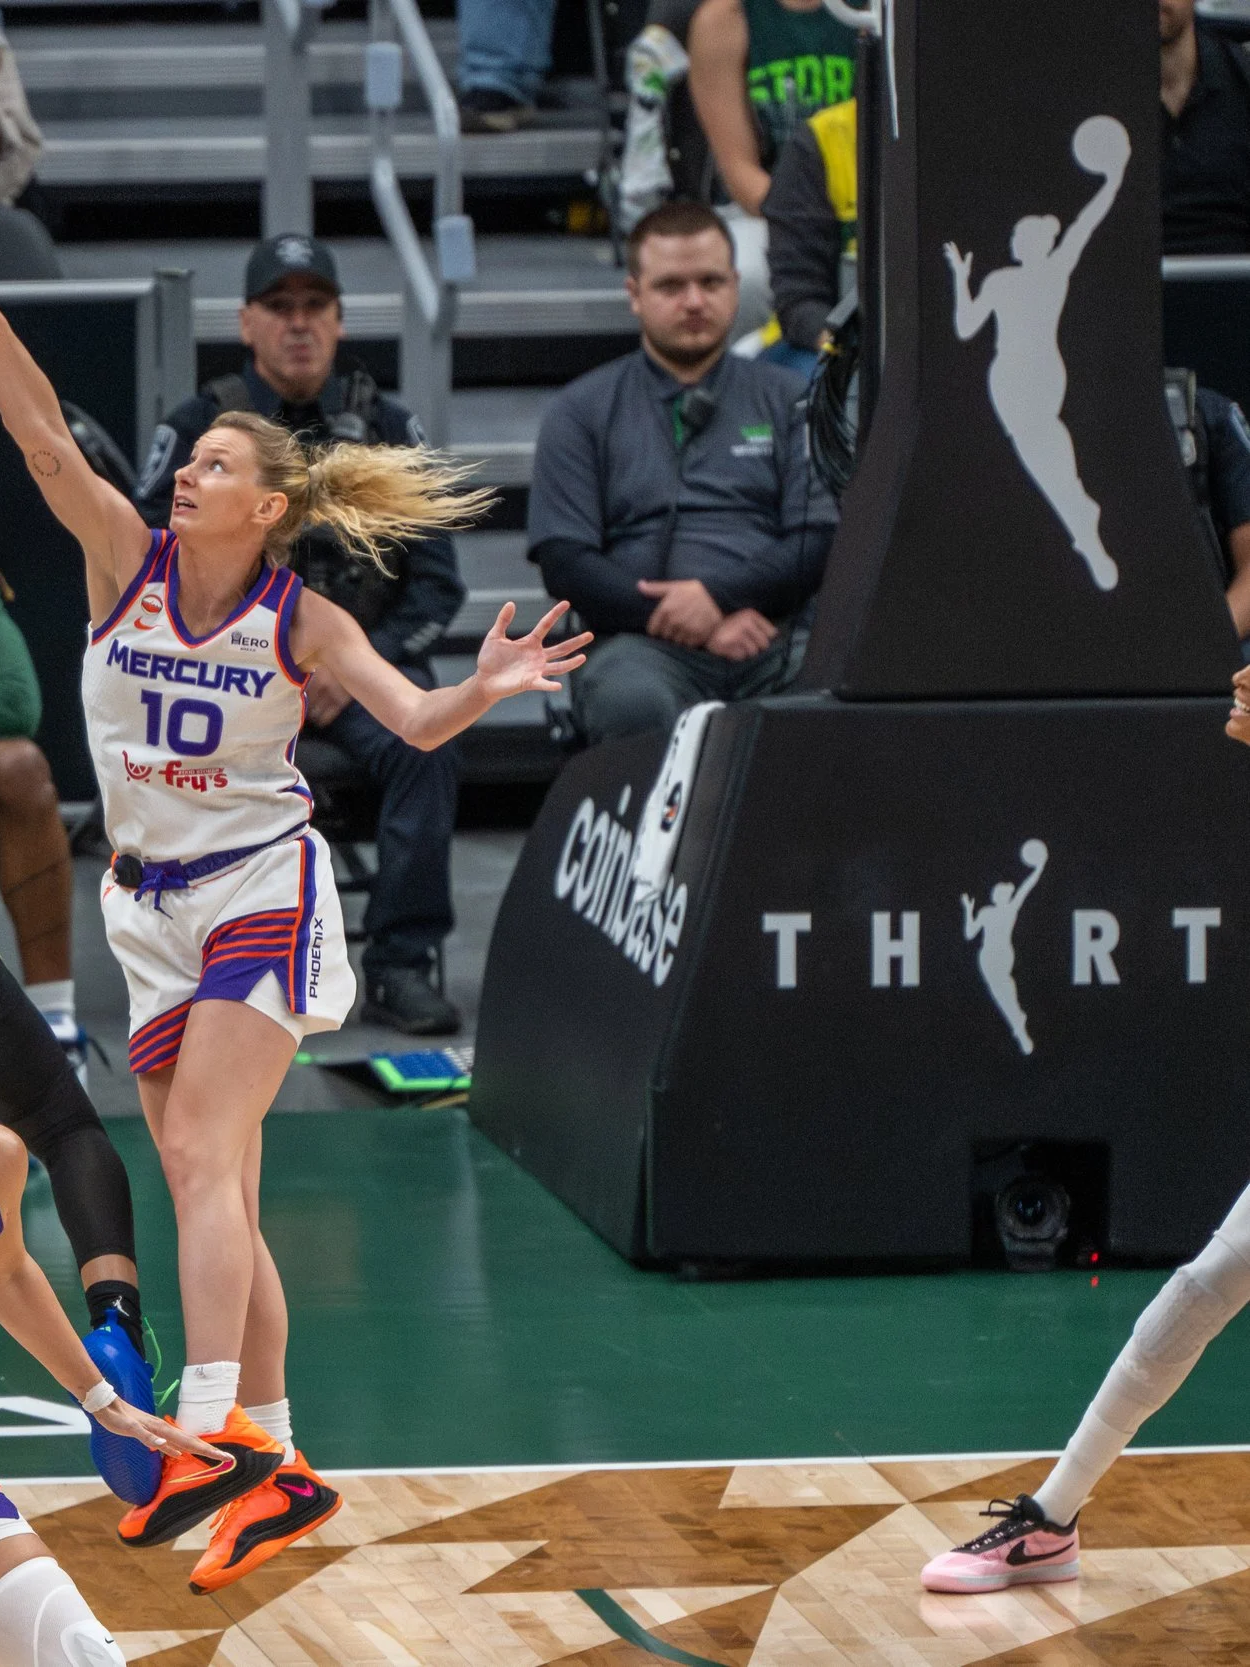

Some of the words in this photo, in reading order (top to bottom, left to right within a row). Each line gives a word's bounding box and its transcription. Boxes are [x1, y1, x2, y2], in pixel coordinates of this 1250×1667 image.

[748, 55, 855, 104] STOR
[106, 638, 277, 699] MERCURY
[231, 631, 269, 649] HERO
[140, 688, 224, 758] 10
[309, 916, 323, 998] PHOENIX
